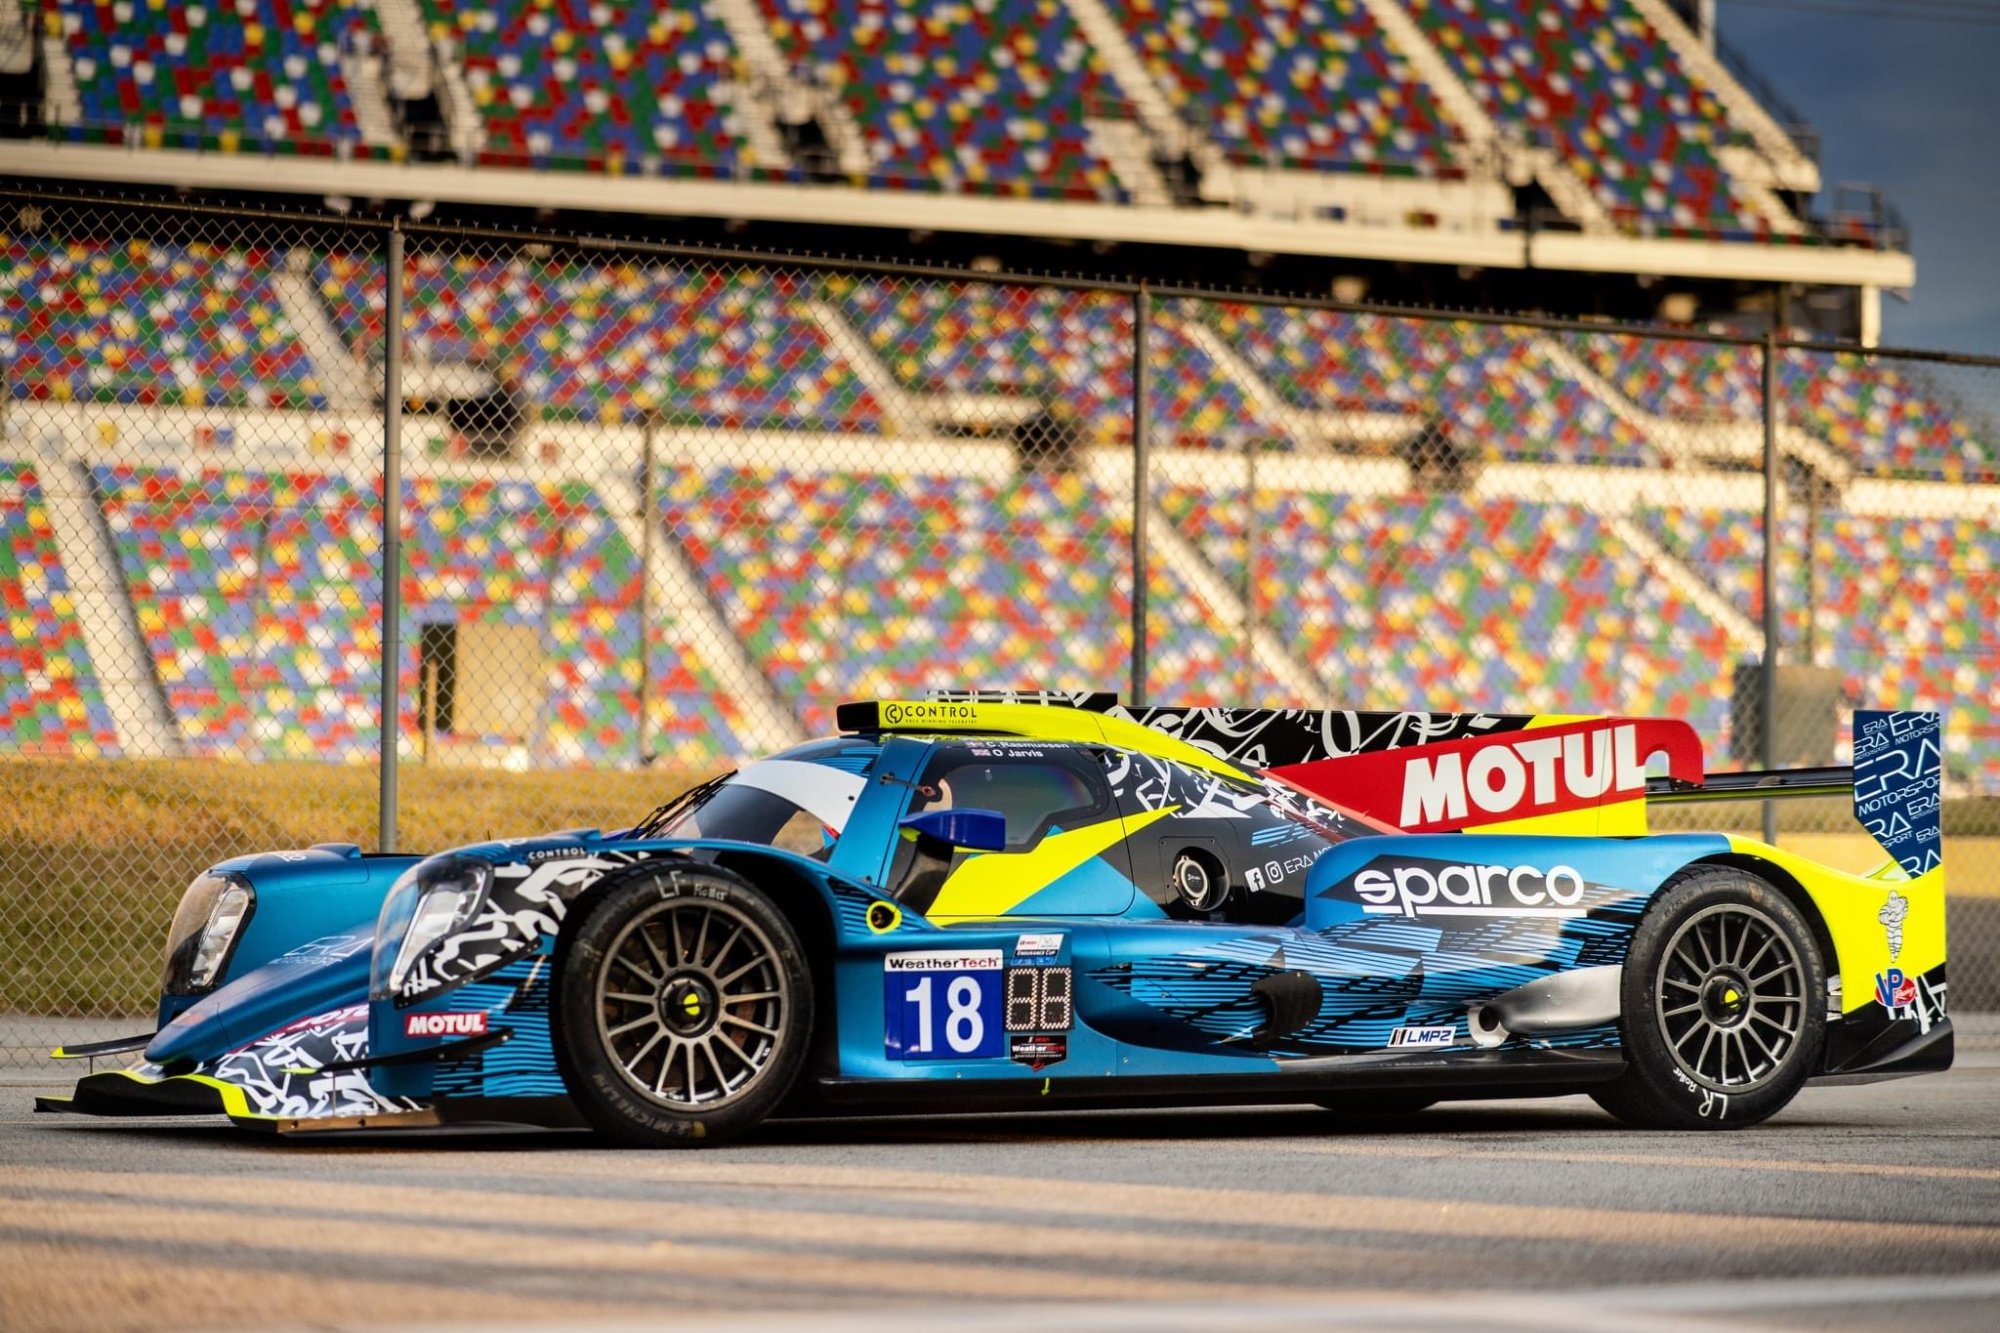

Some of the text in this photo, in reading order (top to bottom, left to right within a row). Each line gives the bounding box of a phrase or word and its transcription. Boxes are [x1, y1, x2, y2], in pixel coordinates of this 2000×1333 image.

[904, 705, 978, 719] CONTROL
[1008, 748, 1044, 758] Jarvis
[1399, 723, 1647, 828] MOTUL
[1854, 737, 1941, 803] ERA
[528, 847, 586, 860] CONTROL
[1283, 854, 1314, 874] ERA
[654, 869, 683, 899] LF
[1354, 865, 1585, 919] sparco
[889, 957, 999, 970] WeatherTech
[1875, 968, 1904, 1007] VP
[407, 1013, 485, 1035] MOTUL
[905, 975, 985, 1054] 18
[1407, 1030, 1452, 1043] LMP2
